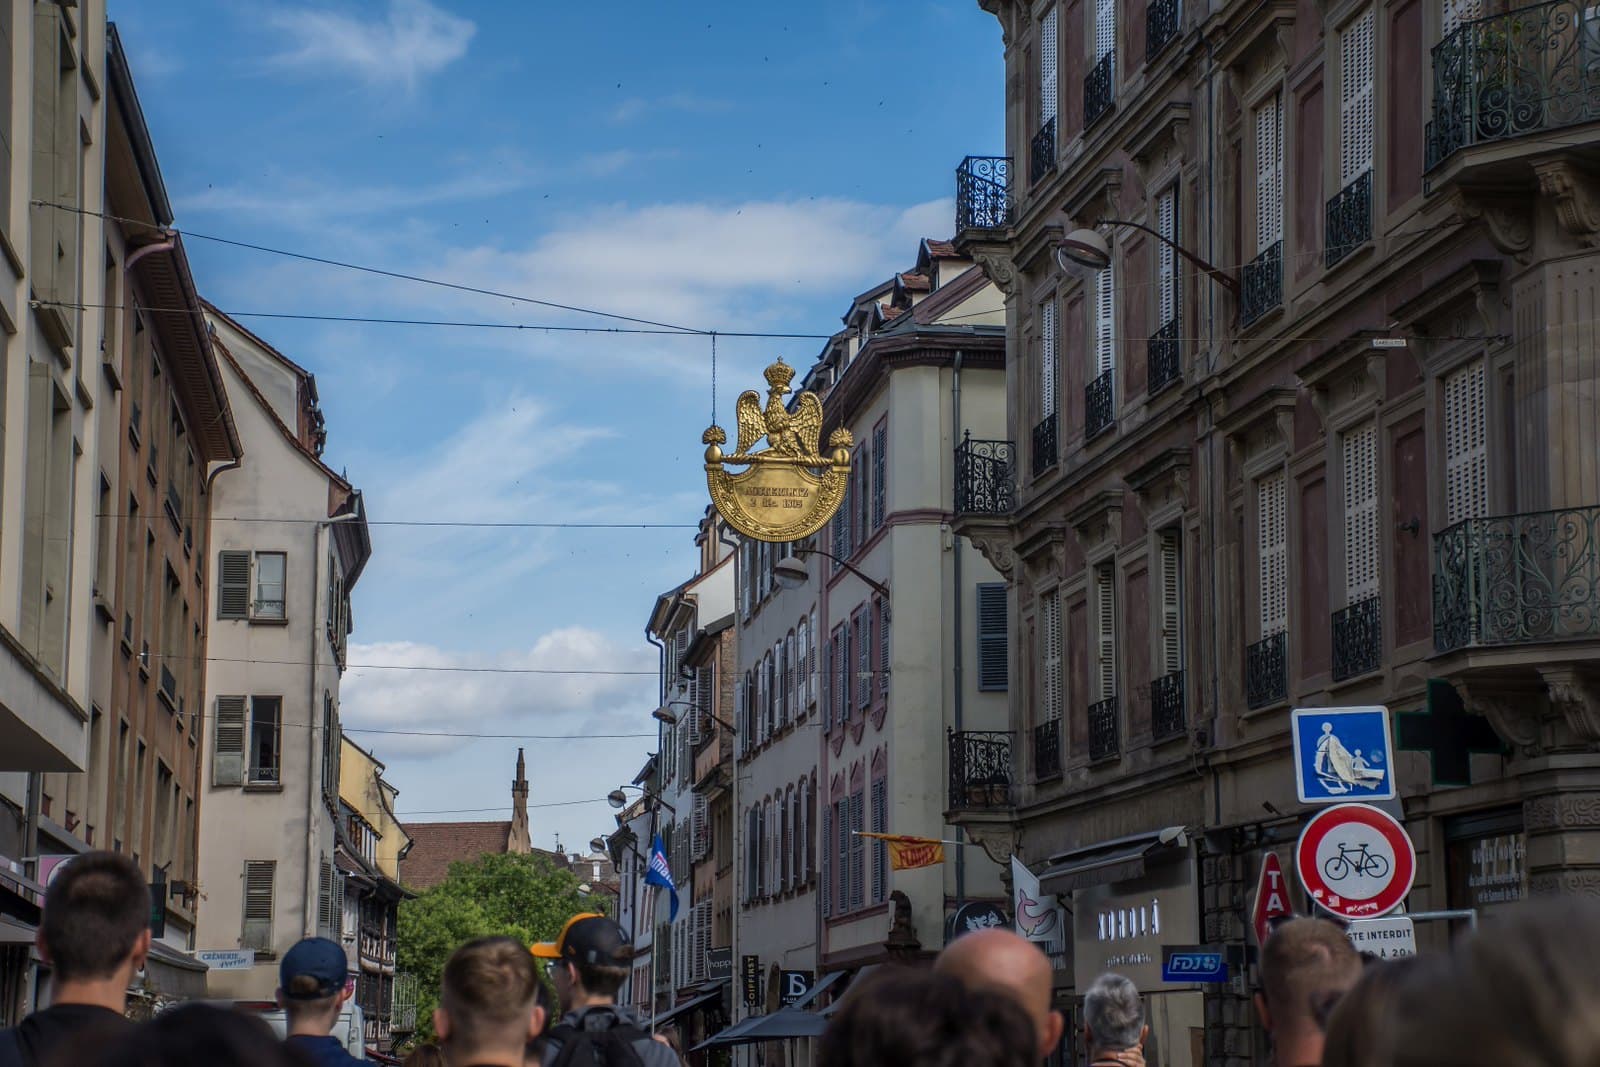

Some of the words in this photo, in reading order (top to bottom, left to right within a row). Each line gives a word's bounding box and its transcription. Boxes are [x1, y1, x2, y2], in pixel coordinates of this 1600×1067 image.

[1367, 929, 1411, 940] INTERDIT
[708, 959, 732, 969] happ
[1172, 957, 1201, 970] FDJ
